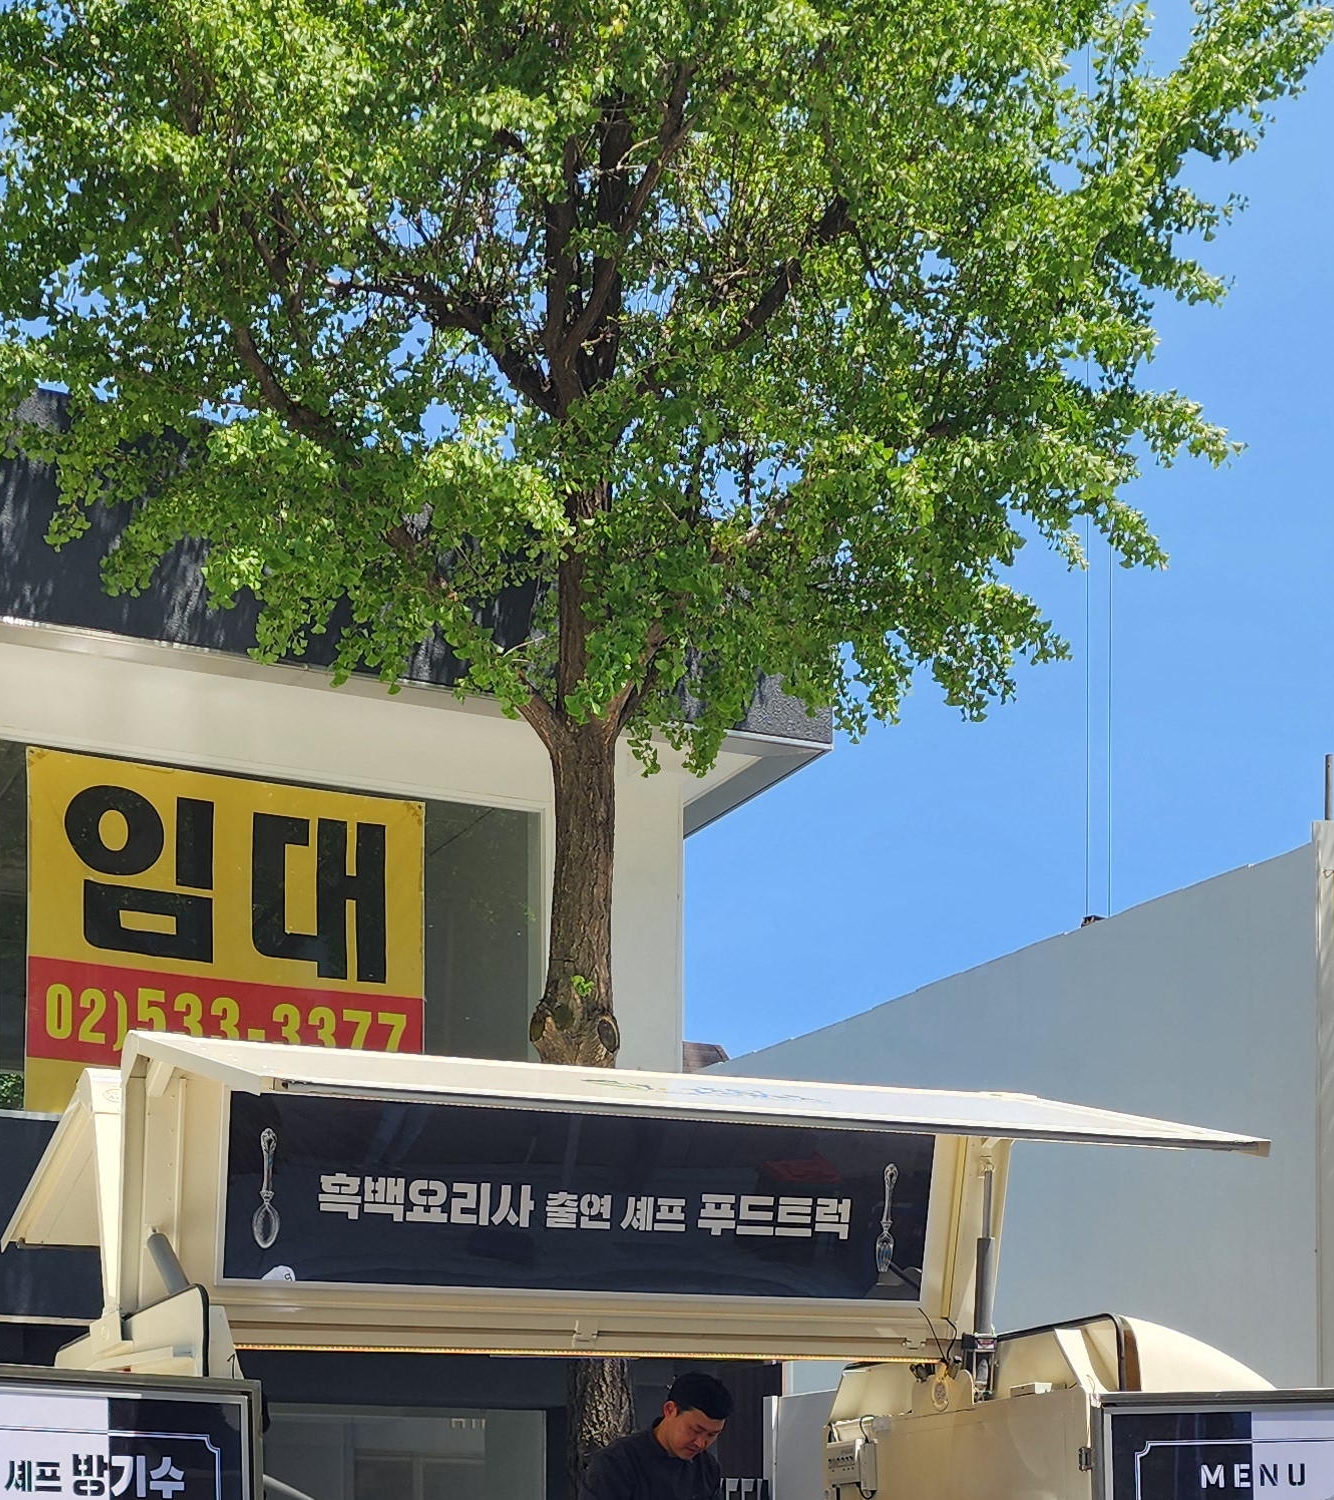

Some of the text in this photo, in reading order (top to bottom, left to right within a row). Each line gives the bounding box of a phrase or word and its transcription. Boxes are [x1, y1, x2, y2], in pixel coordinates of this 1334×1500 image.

[64, 784, 387, 985] 임대
[45, 983, 408, 1053] 02)533-3377
[317, 1170, 853, 1241] 흑백요리사 출연 셰프 푸드트럭
[4, 1452, 187, 1500] 셰프 방기수
[1200, 1463, 1306, 1489] MENU
